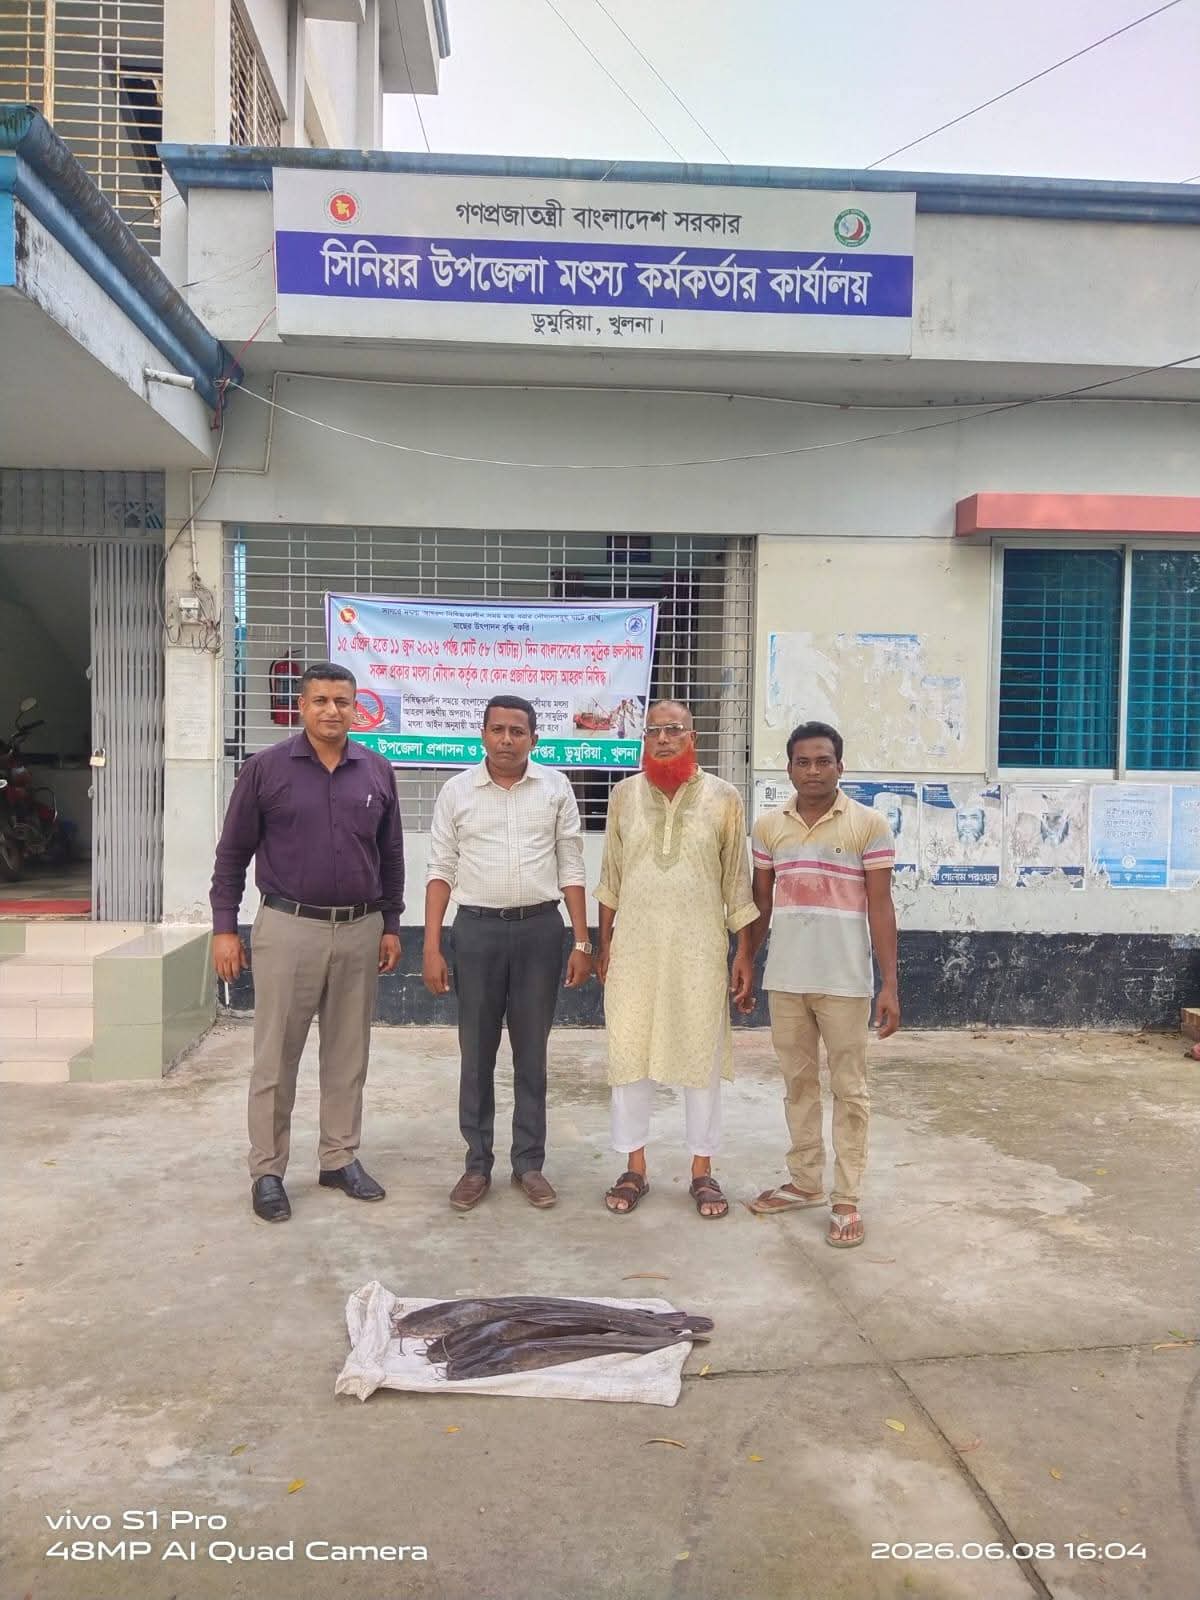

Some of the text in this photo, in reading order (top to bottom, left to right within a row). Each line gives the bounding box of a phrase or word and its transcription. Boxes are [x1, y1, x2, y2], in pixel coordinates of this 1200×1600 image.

[455, 200, 741, 235] গণপ্রজাতন্ত্রী বাংলাদেশ সরকার
[318, 237, 872, 307] সিনিয়র উপজেলা মৎস্য কর্মকর্তার কার্যালয়
[473, 621, 500, 631] উৎপাদন
[502, 623, 514, 633] বৃদ্ধি
[350, 631, 371, 651] এপ্রিল
[372, 638, 389, 653] হতে
[402, 639, 415, 656] জুন
[417, 640, 439, 656] ২০২৬
[461, 638, 477, 656] মোট
[525, 638, 538, 657] দিন
[540, 643, 581, 659] বাংলাদেশের
[583, 639, 610, 662] সামুদ্রিক
[612, 639, 645, 660] জলসীমায়
[369, 664, 388, 679] সকল
[390, 665, 410, 680] প্রকার
[412, 666, 431, 680] মৎস্য
[457, 662, 478, 688] কর্তৃক
[480, 668, 489, 683] যে
[491, 669, 508, 683] কোন
[510, 664, 538, 684] প্রজাতির
[540, 670, 558, 685] মৎস্য
[560, 670, 584, 685] আহরণ
[377, 737, 423, 756] উপজেলা
[426, 742, 464, 757] প্রশাসন
[467, 744, 477, 757] ও
[610, 747, 638, 764] খুলনা
